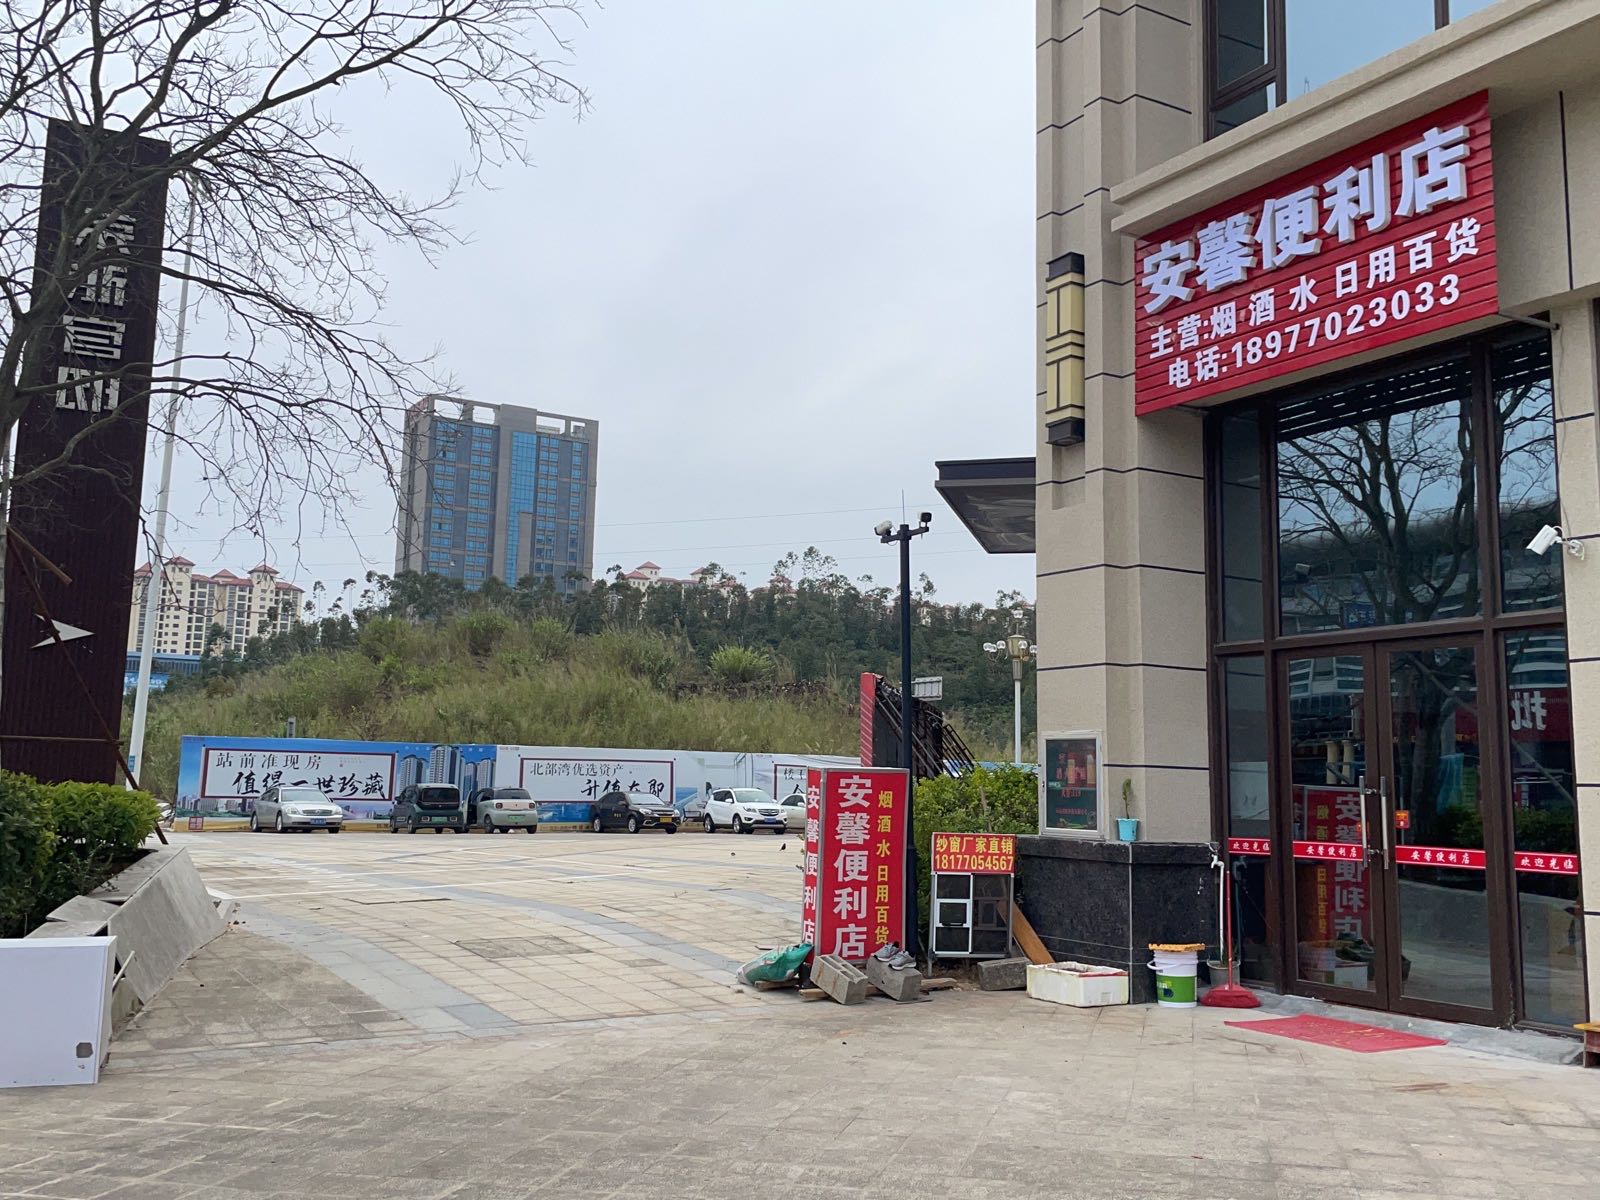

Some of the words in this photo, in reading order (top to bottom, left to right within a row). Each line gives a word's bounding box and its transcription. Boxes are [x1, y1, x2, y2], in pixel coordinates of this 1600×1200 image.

[1141, 124, 1470, 313] 安馨便利店
[216, 753, 322, 770] 站前准现房
[530, 763, 624, 777] 北部湾优选资产
[232, 770, 386, 799] 值得一世珍藏
[936, 835, 1013, 855] 纱窗厂家直销
[802, 785, 820, 945] 安馨便利店
[833, 775, 872, 958] 安馨便利店
[935, 855, 1014, 871] 18177054567
[1410, 850, 1470, 865] 安馨便利店
[1520, 856, 1574, 870] 欢迎光临
[875, 791, 893, 945] 烟酒水日用百货
